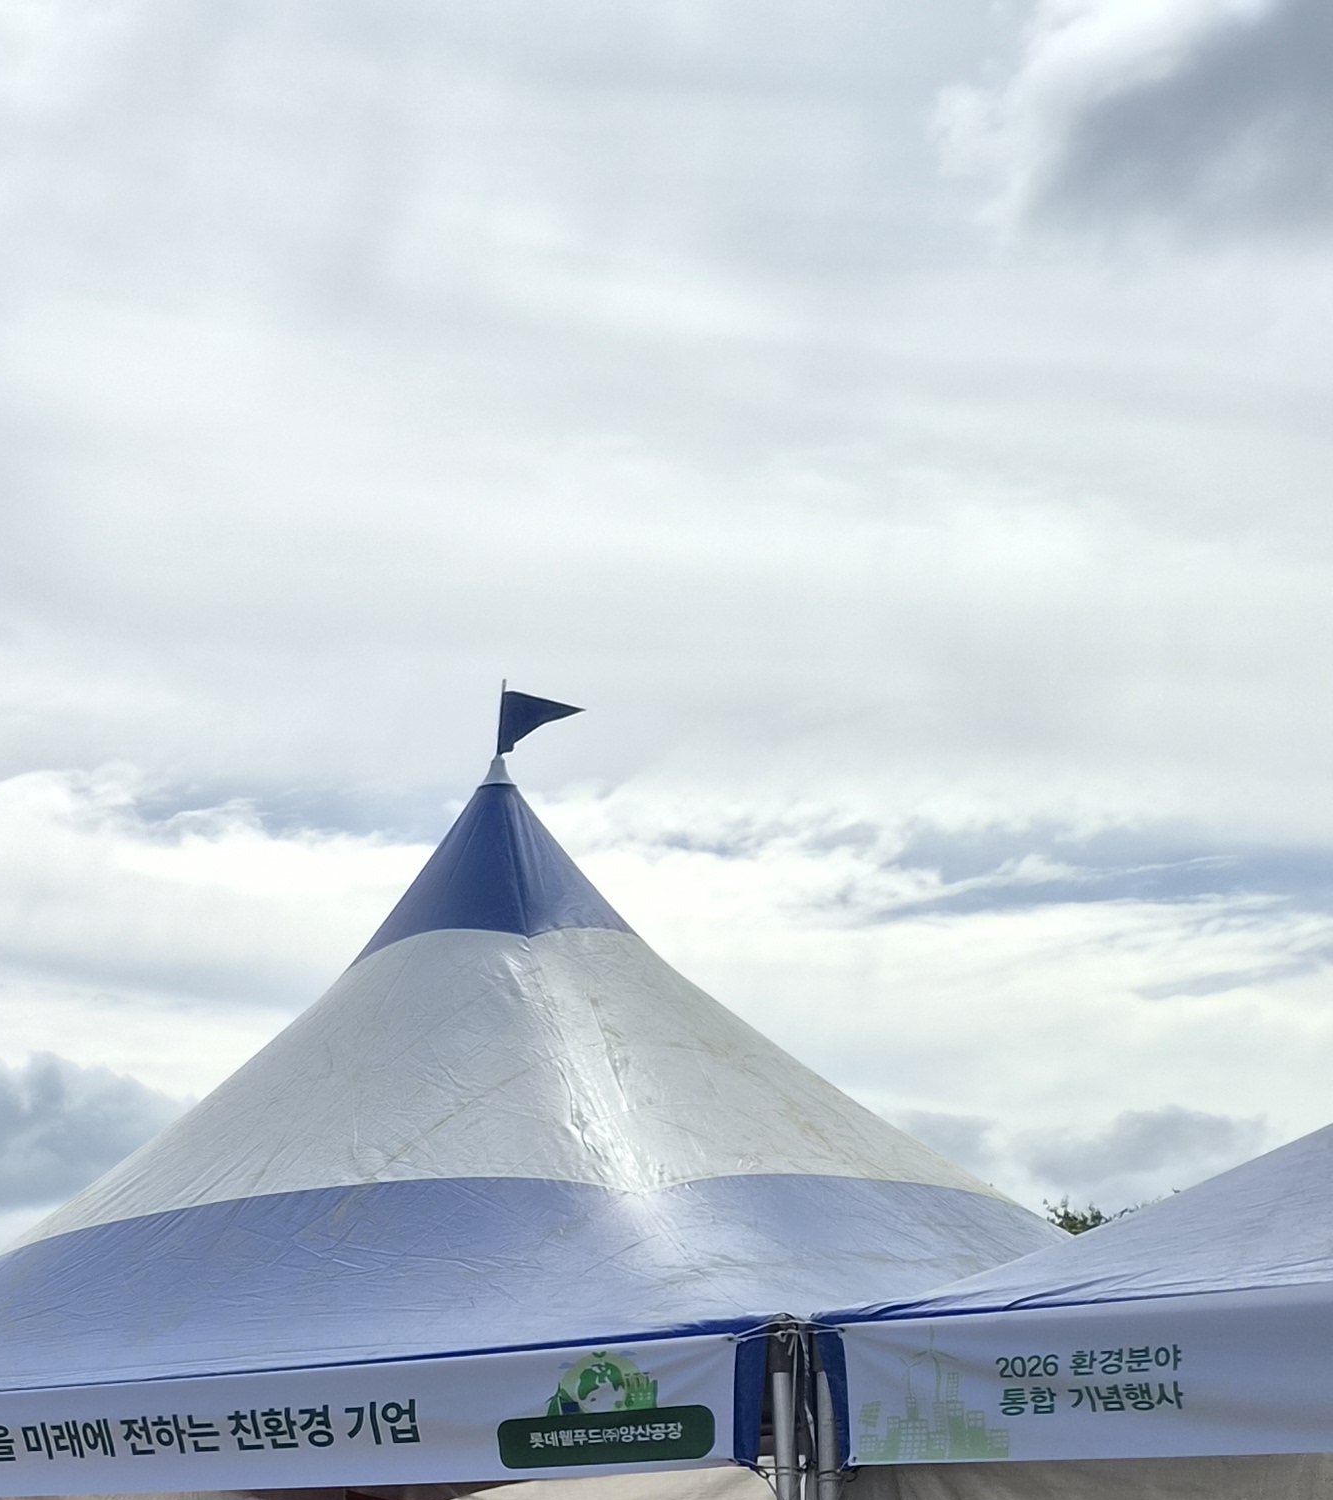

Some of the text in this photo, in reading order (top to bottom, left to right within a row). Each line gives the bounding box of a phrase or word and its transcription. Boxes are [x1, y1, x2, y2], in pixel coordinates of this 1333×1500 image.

[995, 1343, 1183, 1379] 2026 환경분야
[999, 1380, 1184, 1416] 통합 기념행사
[20, 1417, 115, 1462] 미래에
[120, 1411, 220, 1457] 전하는
[228, 1403, 335, 1453] 친환경
[344, 1398, 422, 1447] 기업
